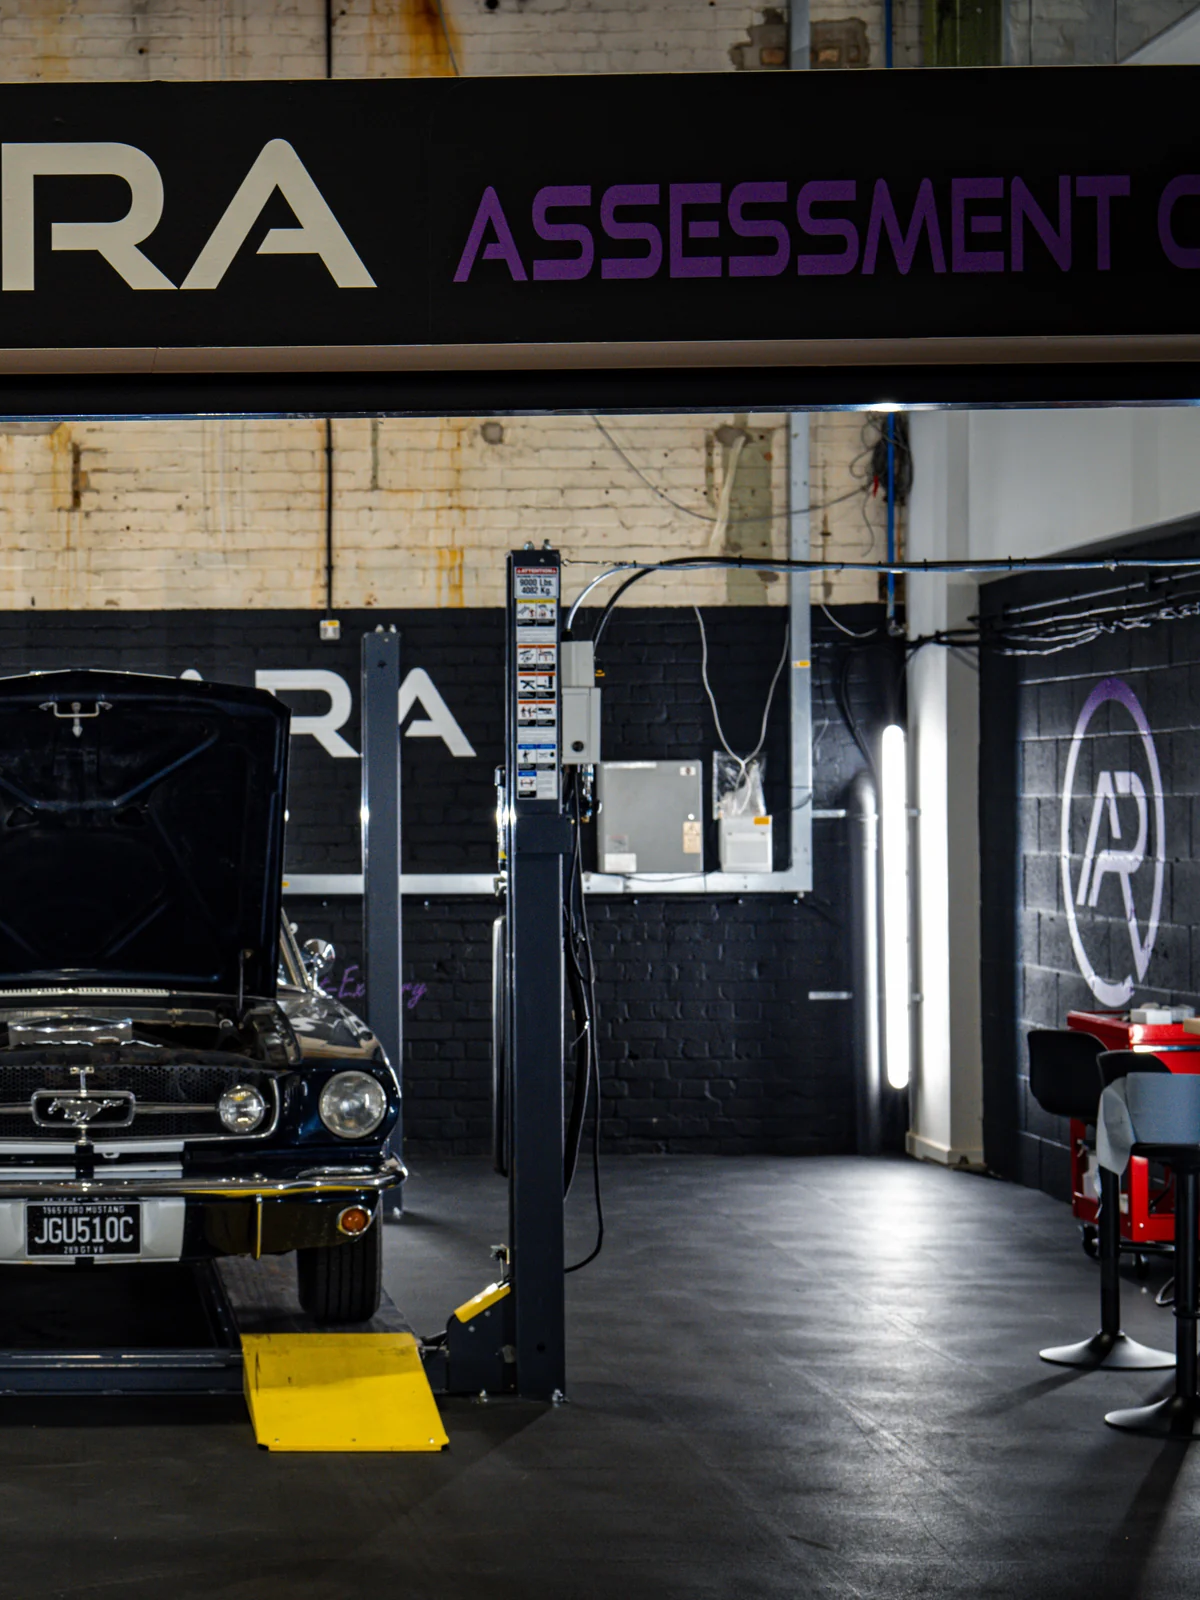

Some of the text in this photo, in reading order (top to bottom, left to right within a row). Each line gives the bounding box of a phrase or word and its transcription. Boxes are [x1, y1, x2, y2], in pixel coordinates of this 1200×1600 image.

[453, 175, 1131, 283] ASSESSMENT
[42, 1205, 125, 1215] 1965 FORD MUSTANG
[34, 1216, 134, 1244] JGU510C
[63, 1246, 79, 1254] 289
[80, 1246, 91, 1254] GT
